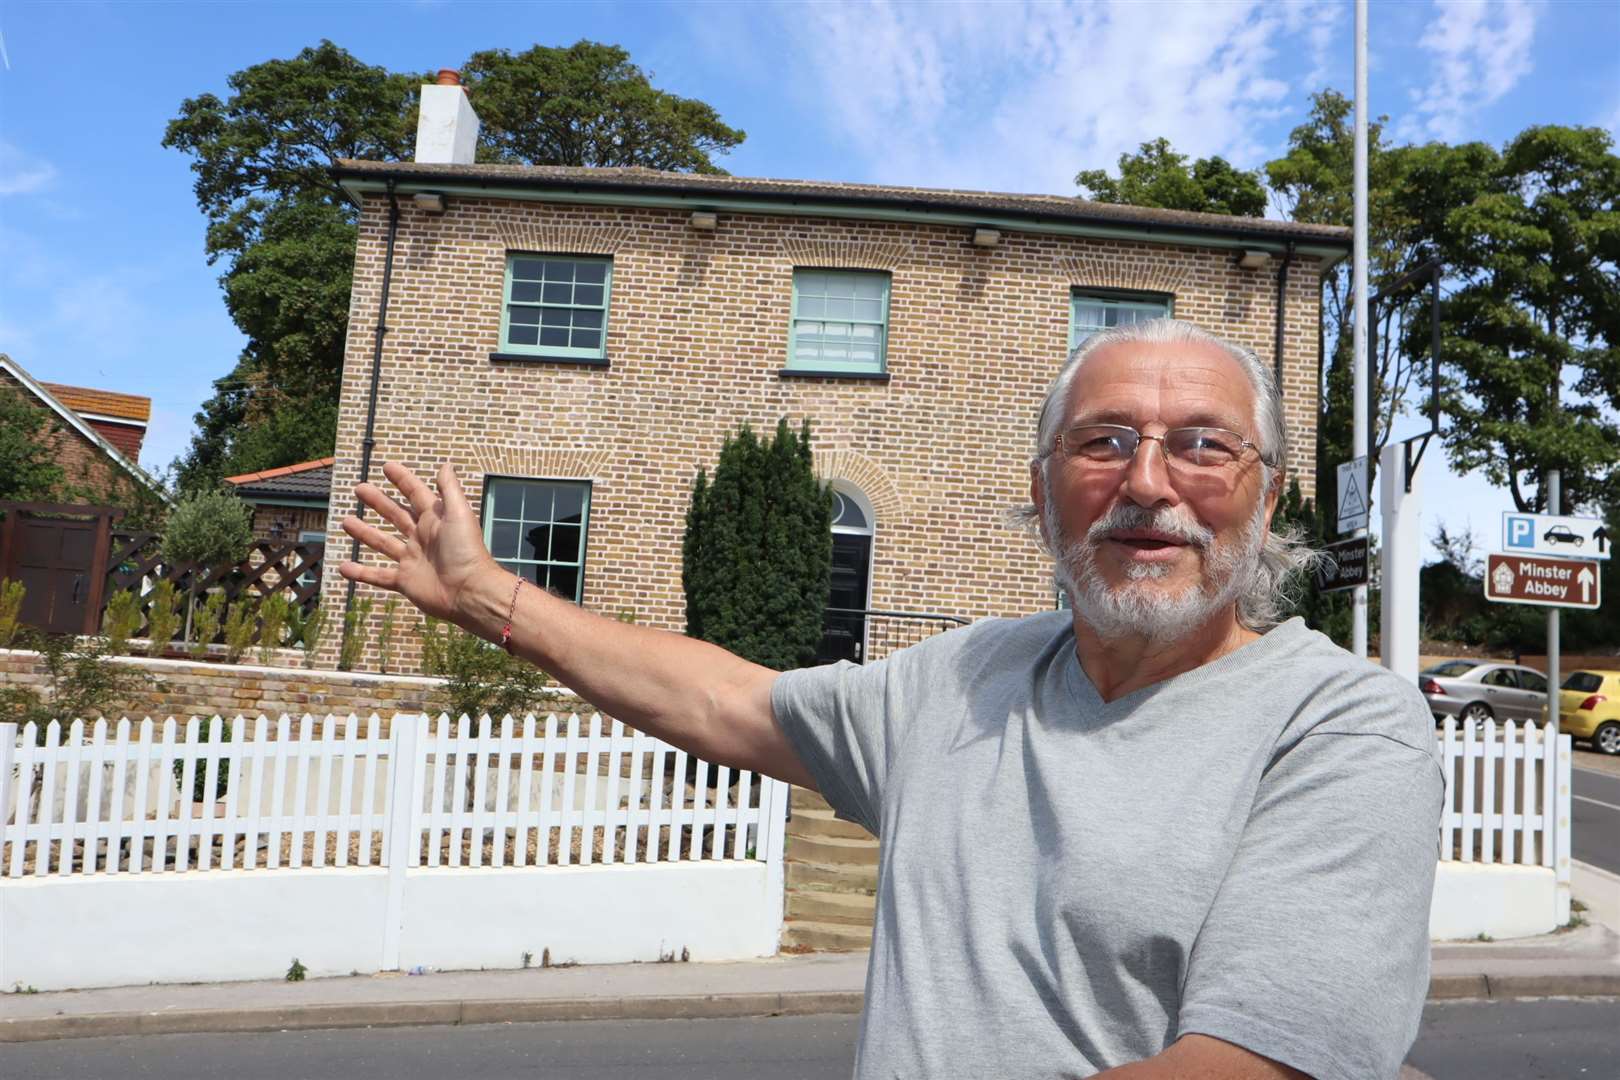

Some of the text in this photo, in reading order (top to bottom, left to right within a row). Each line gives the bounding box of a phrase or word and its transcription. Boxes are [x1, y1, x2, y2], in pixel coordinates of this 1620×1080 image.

[1512, 519, 1530, 545] P
[1338, 547, 1366, 562] Minster
[1519, 561, 1572, 580] Minster
[1524, 579, 1568, 599] Abbey
